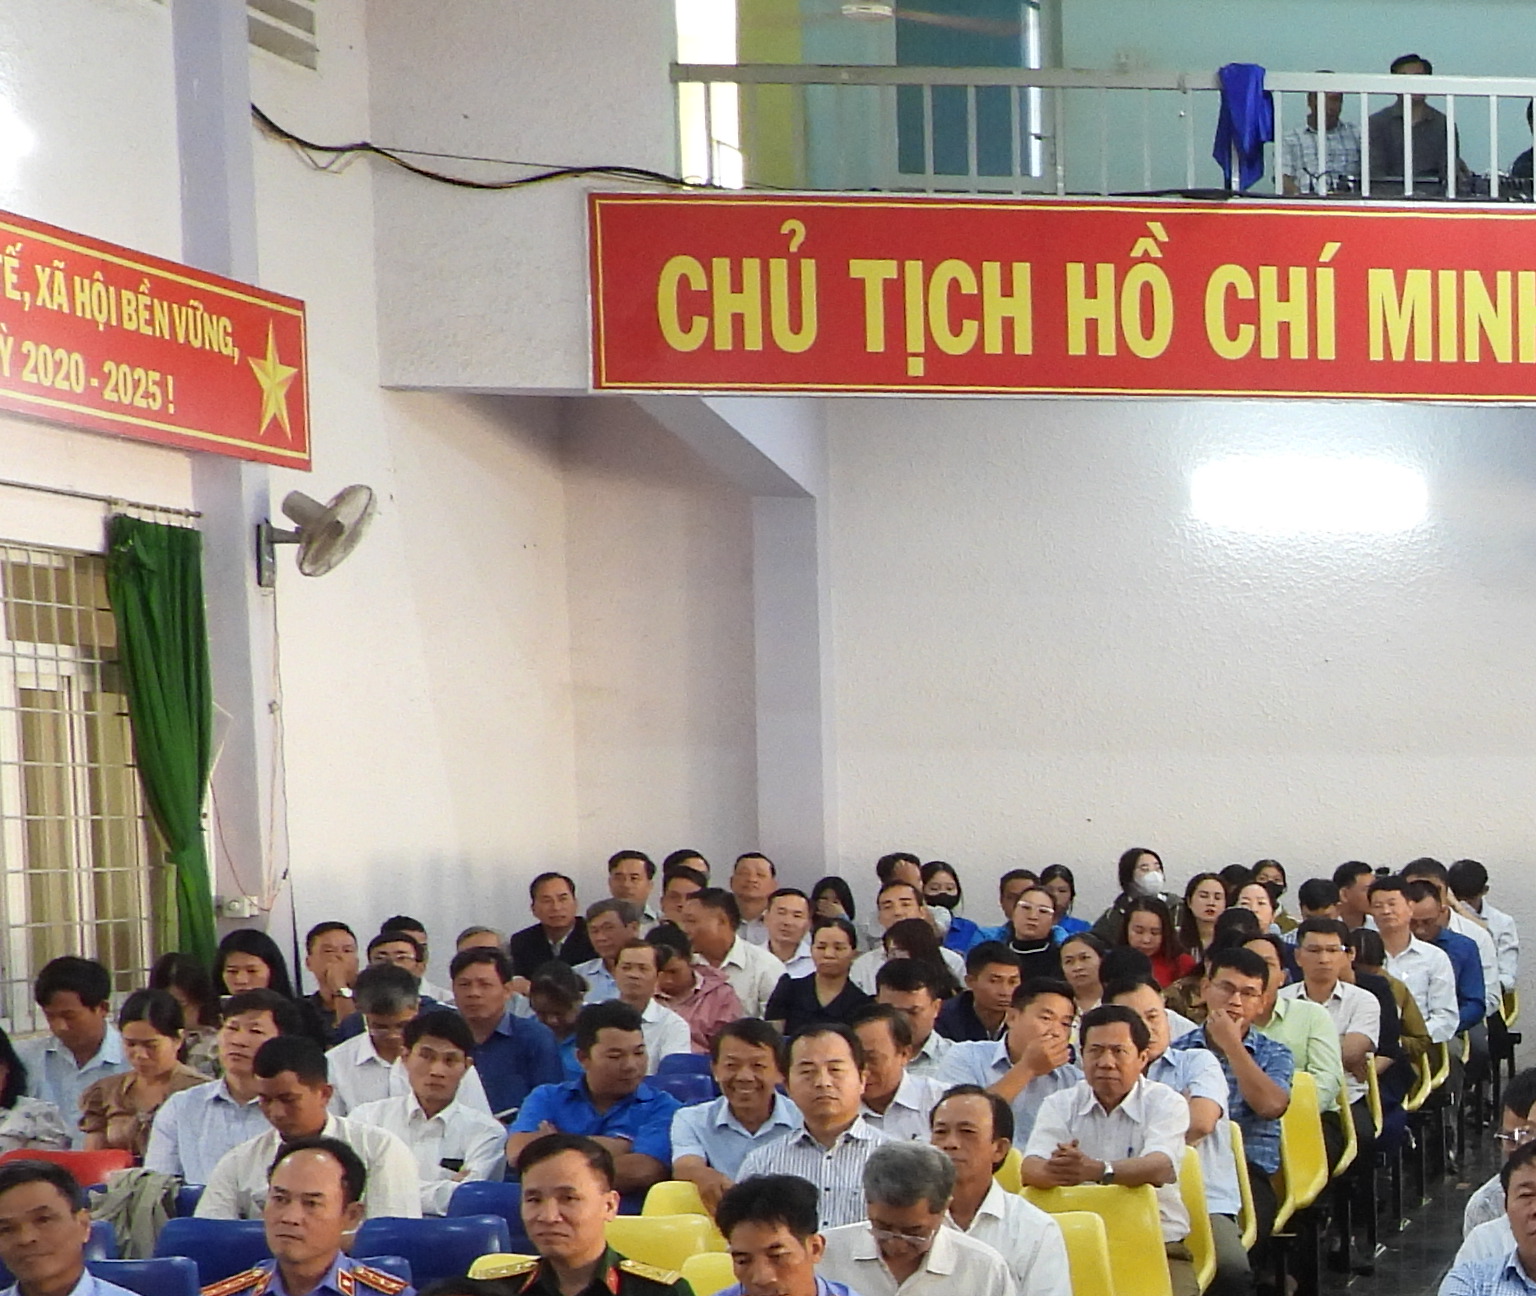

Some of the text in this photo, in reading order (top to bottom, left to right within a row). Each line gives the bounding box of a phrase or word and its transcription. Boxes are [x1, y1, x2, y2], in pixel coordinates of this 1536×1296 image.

[0, 242, 241, 365] Ế, XÃ HỘI BỀN VỮNG,
[658, 219, 818, 353] CHỦ
[848, 259, 1034, 376] TỊCH
[1066, 221, 1175, 359] HỒ
[1205, 241, 1341, 360] CHÍ
[20, 340, 85, 394] 2020
[102, 359, 163, 411] 2025
[166, 375, 175, 414] !
